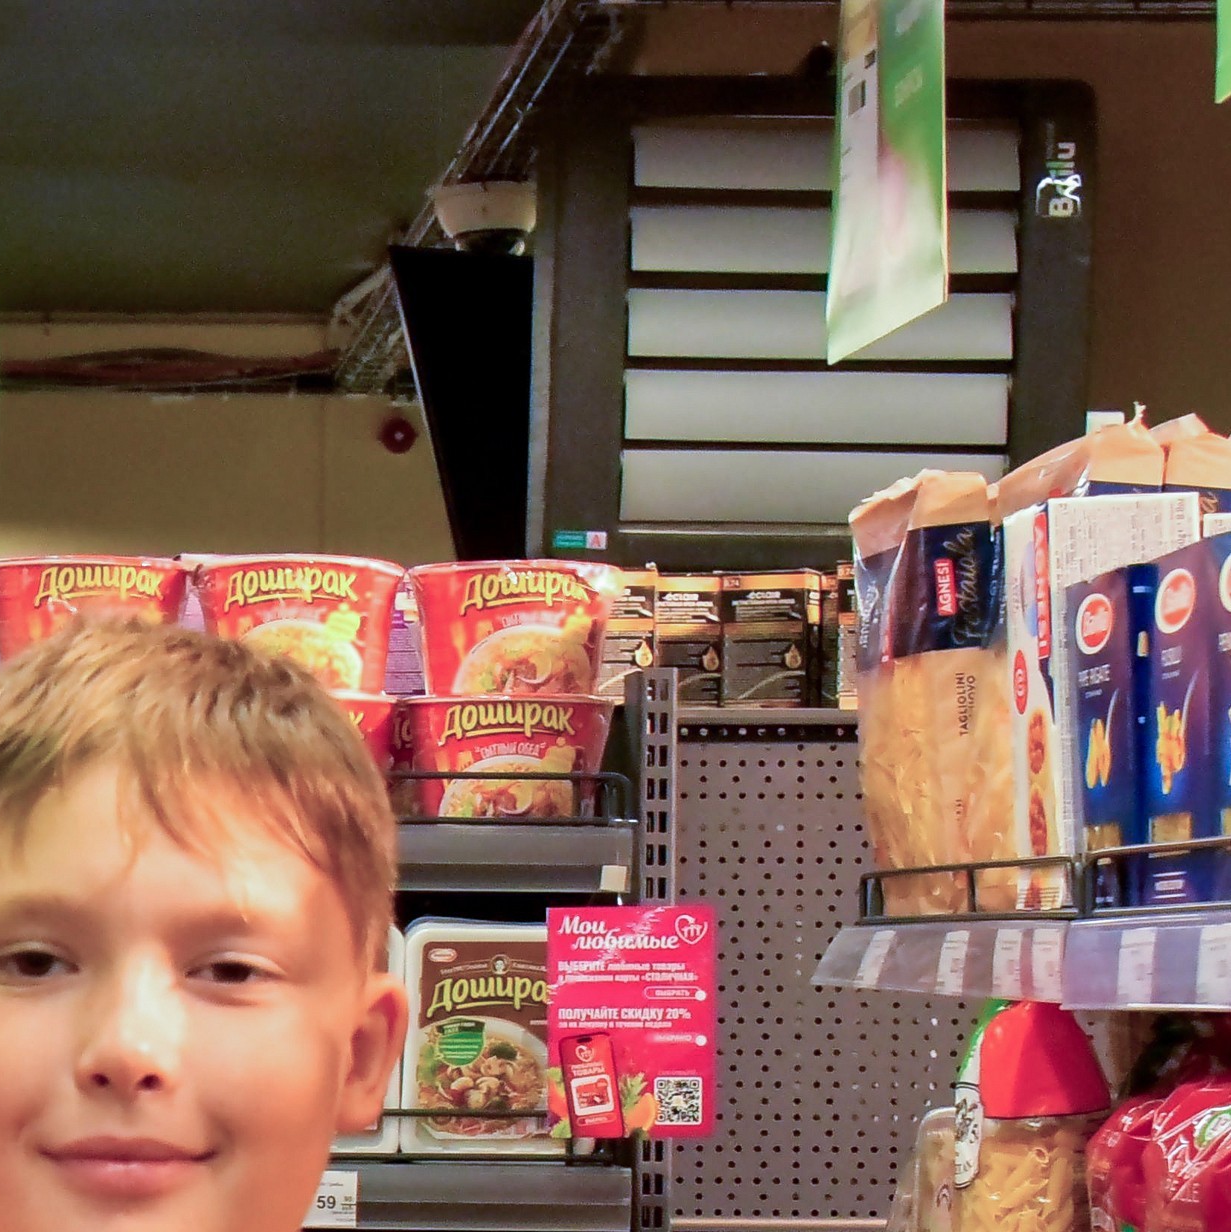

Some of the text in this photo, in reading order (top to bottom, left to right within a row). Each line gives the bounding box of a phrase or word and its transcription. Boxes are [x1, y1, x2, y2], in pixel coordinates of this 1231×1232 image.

[35, 565, 164, 606] Доширак
[224, 567, 358, 613] Доширак
[936, 562, 955, 615] AGNESI
[438, 703, 575, 746] Доширак
[955, 672, 968, 737] TAGLIOLINI
[558, 915, 607, 935] Мои
[572, 928, 679, 950] любимые
[426, 976, 549, 1018] Дошира
[558, 1006, 619, 1021] ПОЛУЧАЙТЕ
[621, 1008, 665, 1021] СКИДКУ
[315, 1195, 336, 1210] 59
